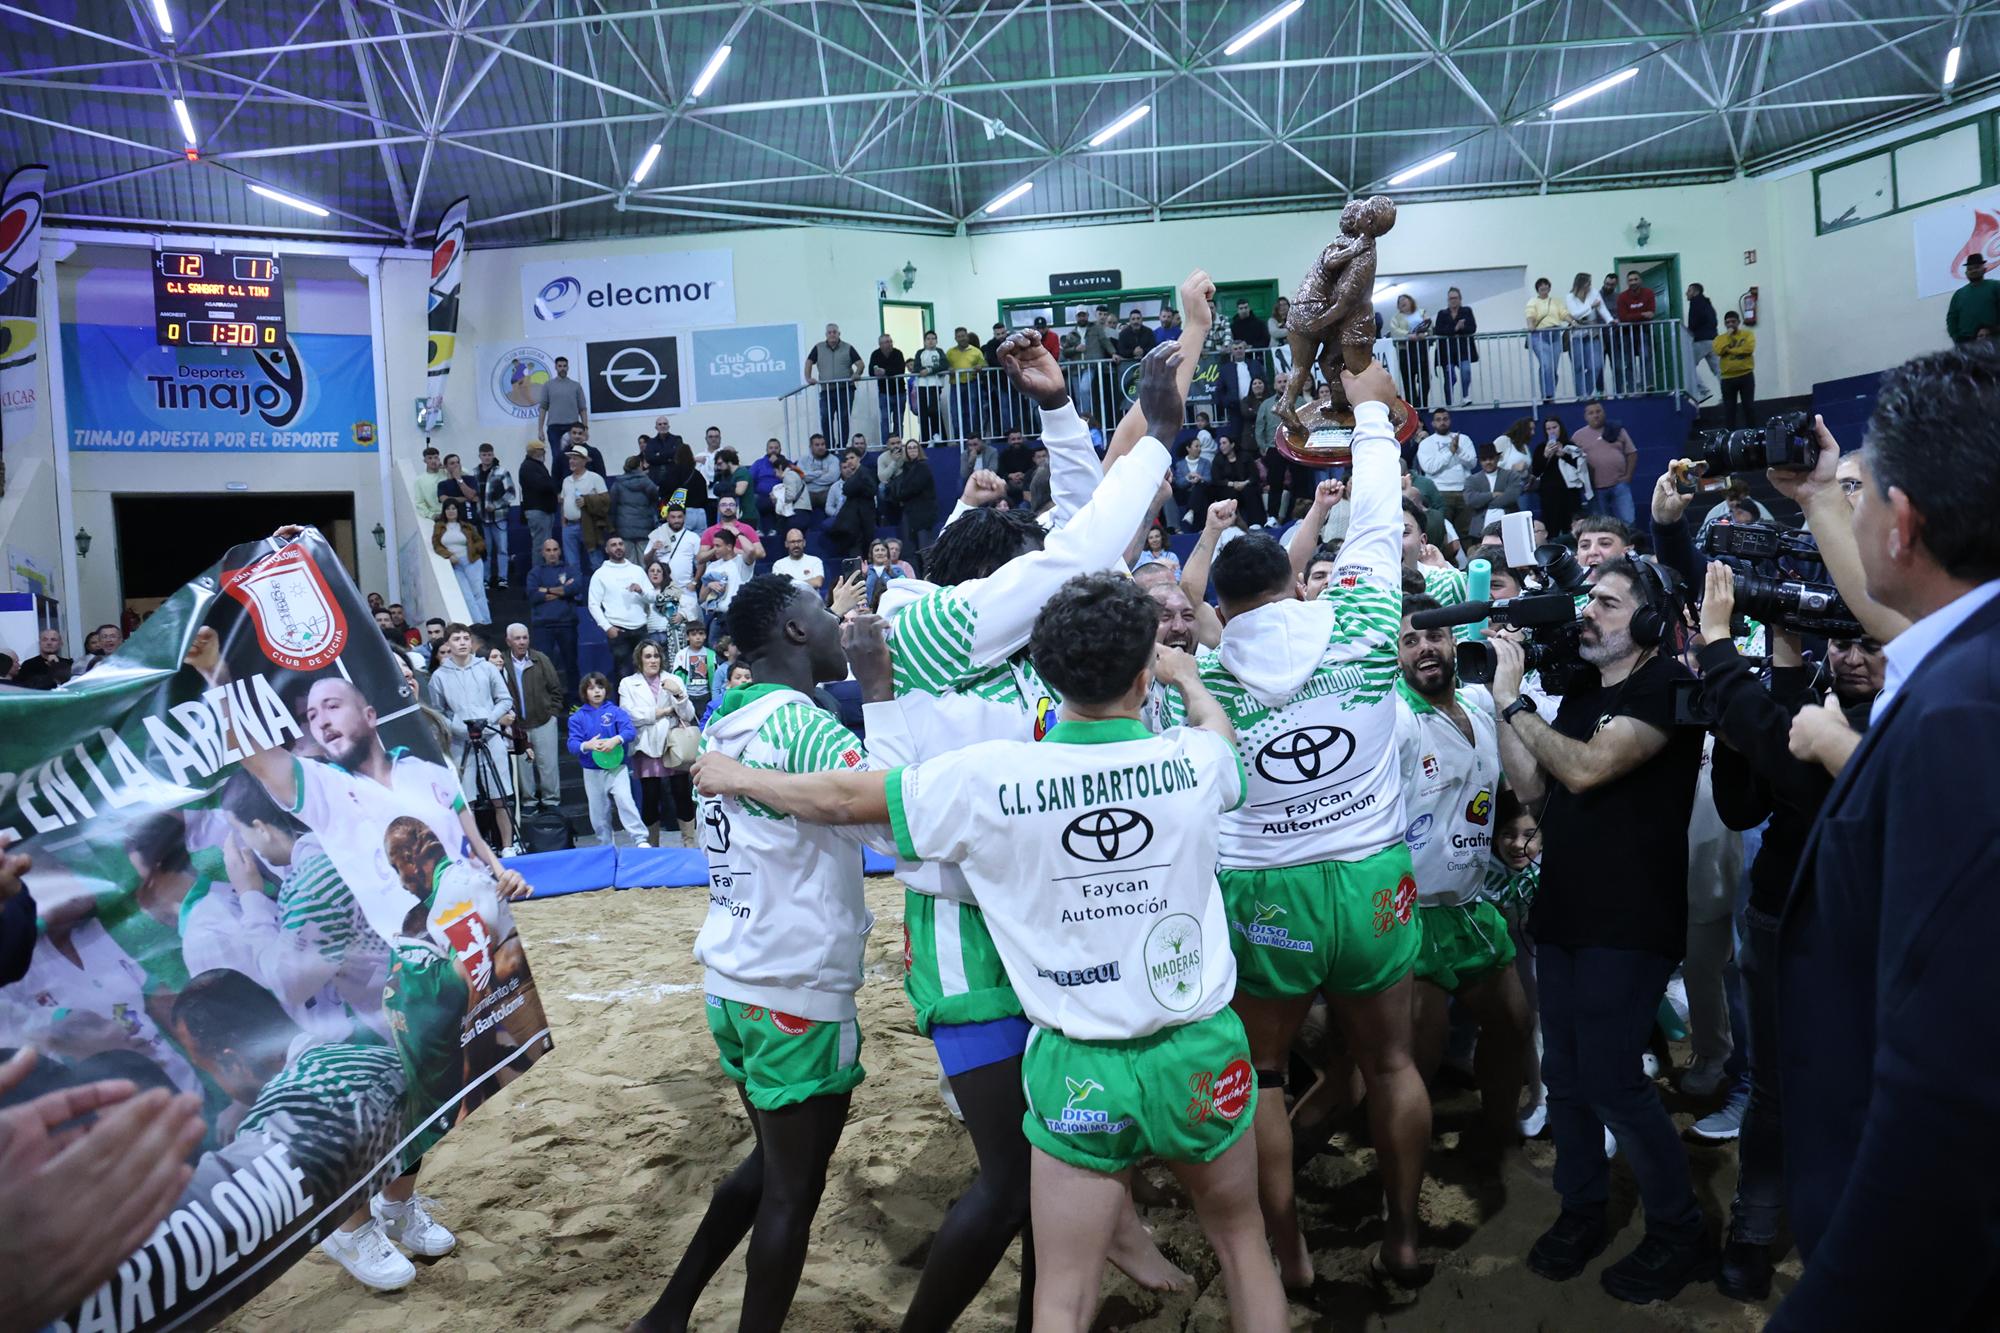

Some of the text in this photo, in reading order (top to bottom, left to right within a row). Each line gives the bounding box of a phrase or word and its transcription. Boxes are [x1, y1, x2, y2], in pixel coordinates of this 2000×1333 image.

[179, 256, 200, 276] 12
[250, 260, 271, 279] 11
[1059, 276, 1112, 287] LA CANTINA
[586, 281, 717, 309] elecmor
[168, 323, 276, 344] 0 1:30 0
[715, 352, 745, 364] Club
[178, 364, 245, 379] Deportes
[147, 374, 281, 415] Tinajo
[73, 429, 341, 449] TINAJO APUESTA POR EL DEPORTE
[272, 630, 343, 667] CLUB DE LUCHA
[16, 755, 98, 834] EN
[75, 727, 156, 809] LA
[142, 673, 305, 788] ARENA
[998, 782, 1032, 816] C.L.
[1036, 775, 1076, 813] SAN
[1285, 790, 1353, 818] Faycan
[1082, 879, 1149, 898] Faycan
[1061, 897, 1168, 923] Automoción
[1271, 935, 1312, 952] MOZAGA
[1151, 949, 1201, 981] MADERAS
[508, 977, 520, 991] de
[460, 991, 525, 1048] San Bartolomé
